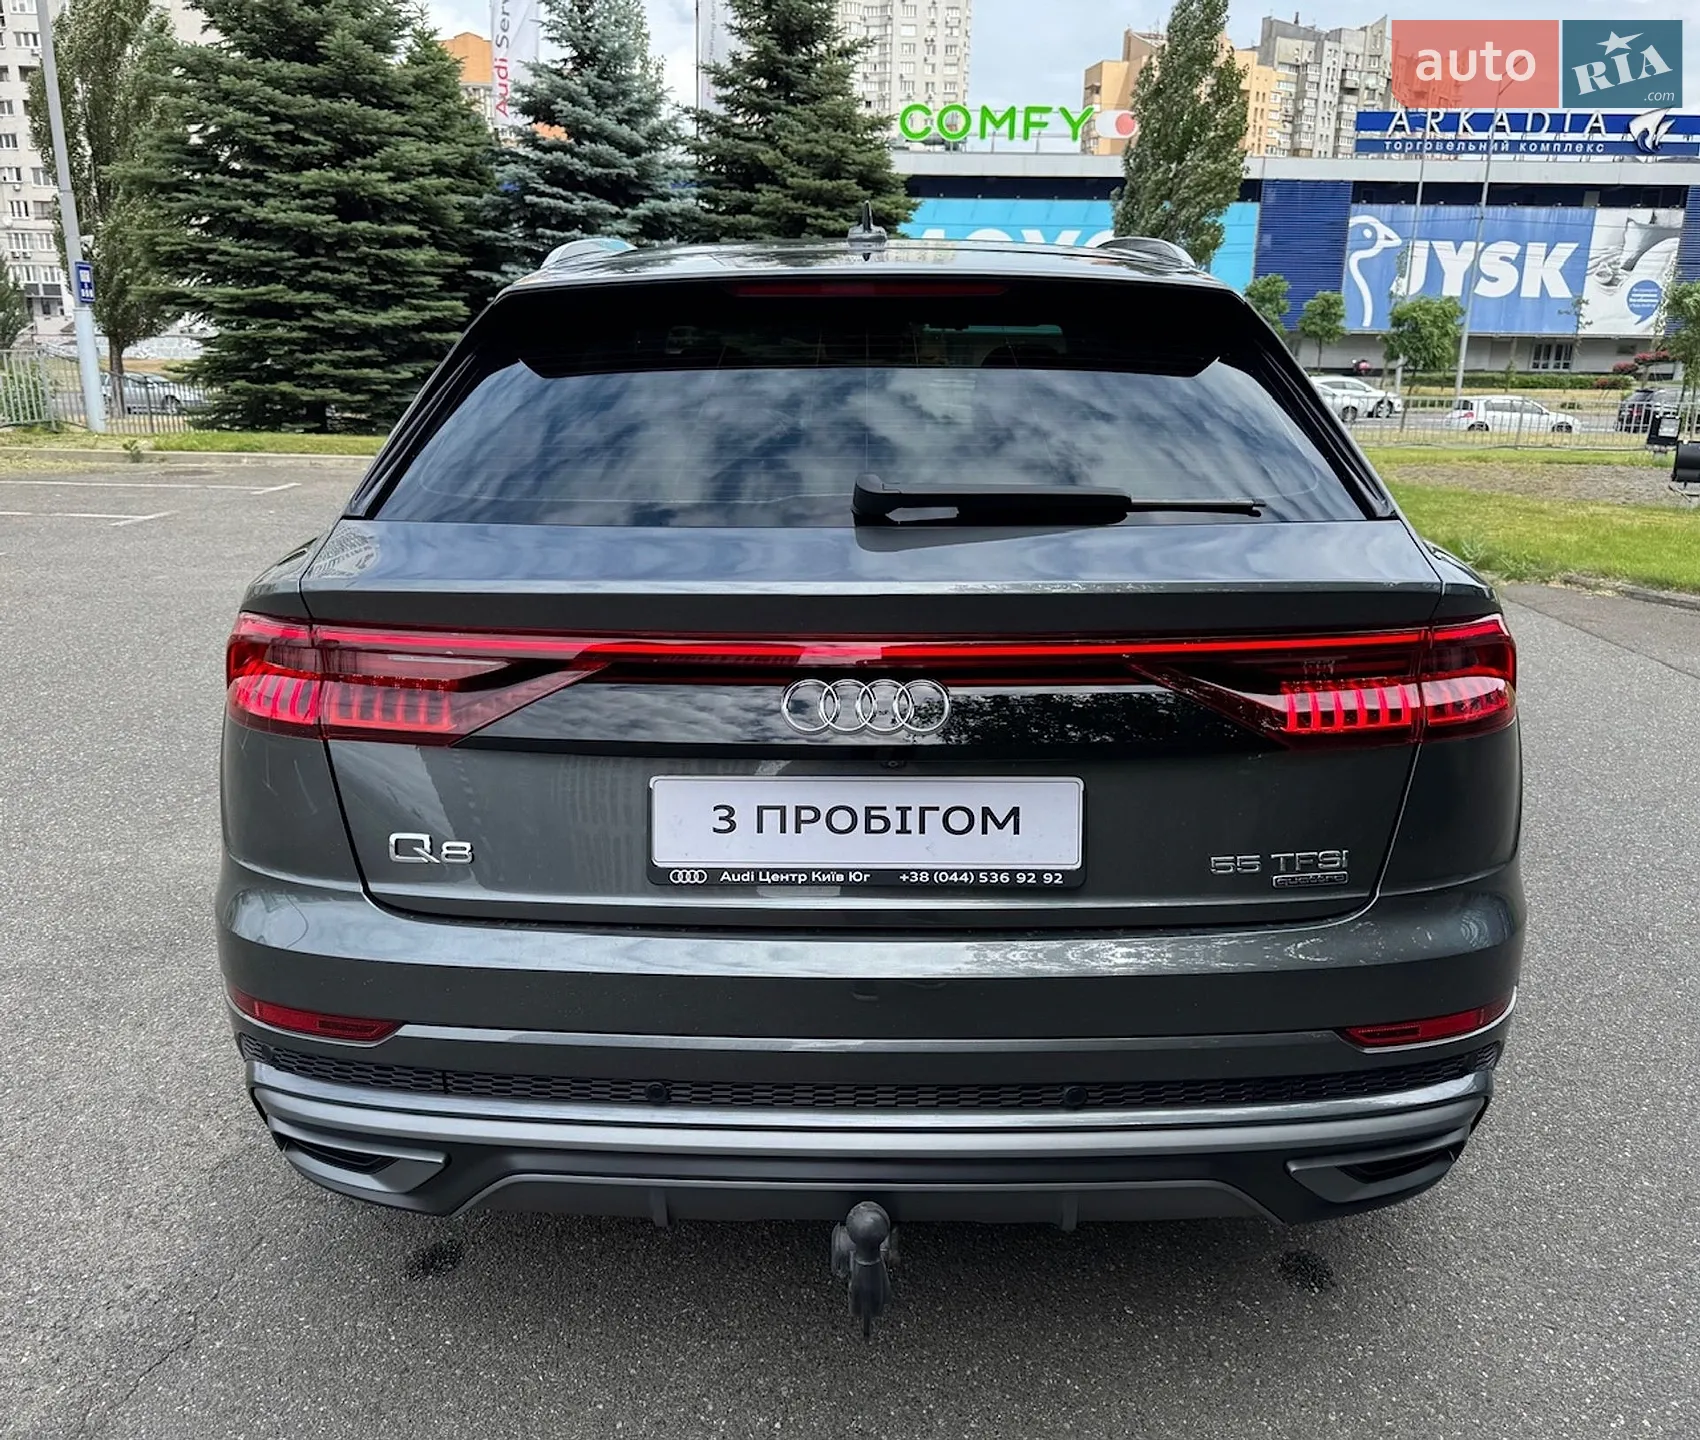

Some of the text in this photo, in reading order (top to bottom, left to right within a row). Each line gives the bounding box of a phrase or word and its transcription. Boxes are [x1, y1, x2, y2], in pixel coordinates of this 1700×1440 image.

[494, 57, 509, 118] Audi
[899, 103, 1095, 142] COMFY
[1386, 109, 1607, 136] ARKADIA
[1384, 140, 1605, 153] торговельний комплекс
[1389, 241, 1579, 298] JYSK
[756, 804, 1021, 836] ПРОБІГОМ
[389, 833, 473, 864] Q8
[719, 871, 871, 886] Audi Центр Київ Юг
[899, 871, 1064, 885] +38 (044) 536 92 92
[1210, 855, 1262, 875] 55
